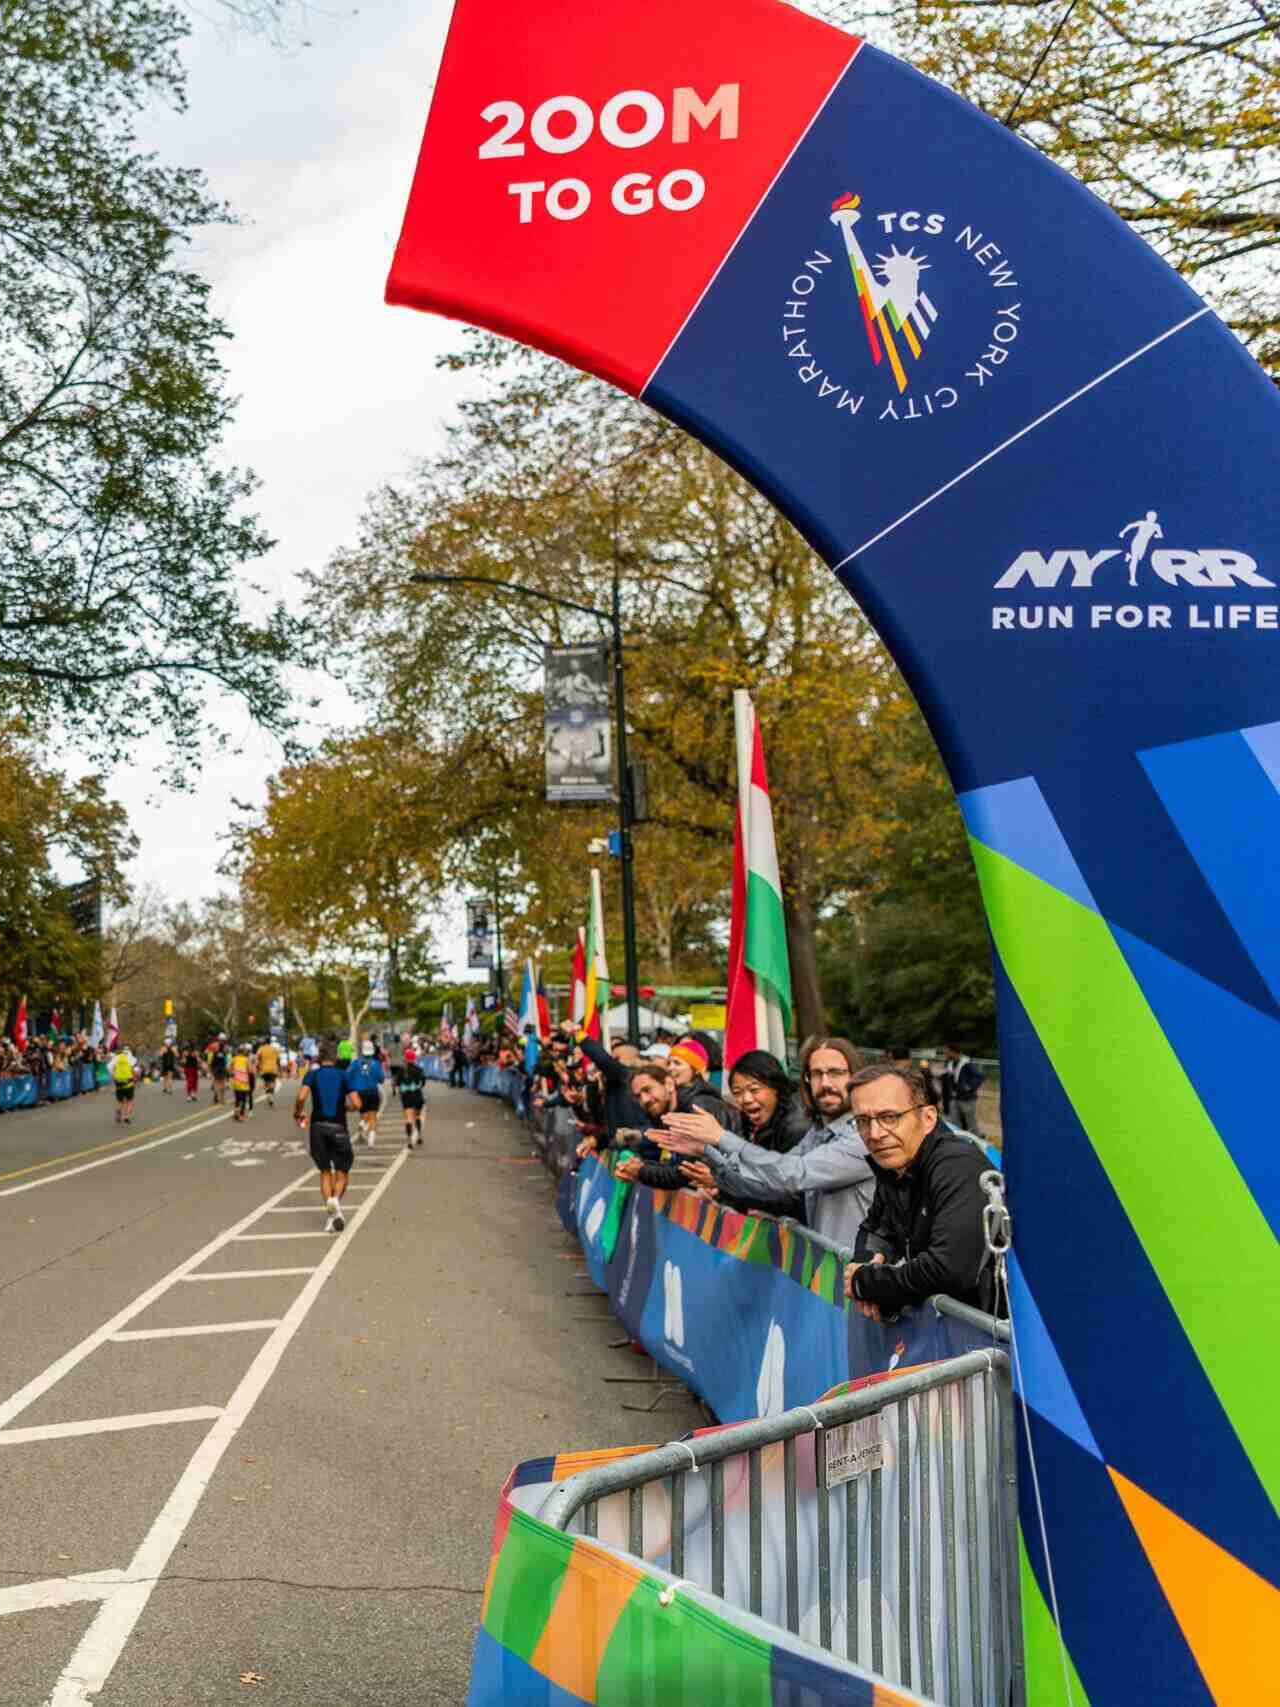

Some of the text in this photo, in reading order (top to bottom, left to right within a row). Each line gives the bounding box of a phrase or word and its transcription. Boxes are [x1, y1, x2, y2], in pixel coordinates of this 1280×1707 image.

[478, 83, 740, 160] 200M
[508, 168, 706, 224] TO GO
[783, 211, 1022, 420] TCS NEW YORK CITY MARATHON
[992, 605, 1279, 630] RUN FOR LIFE
